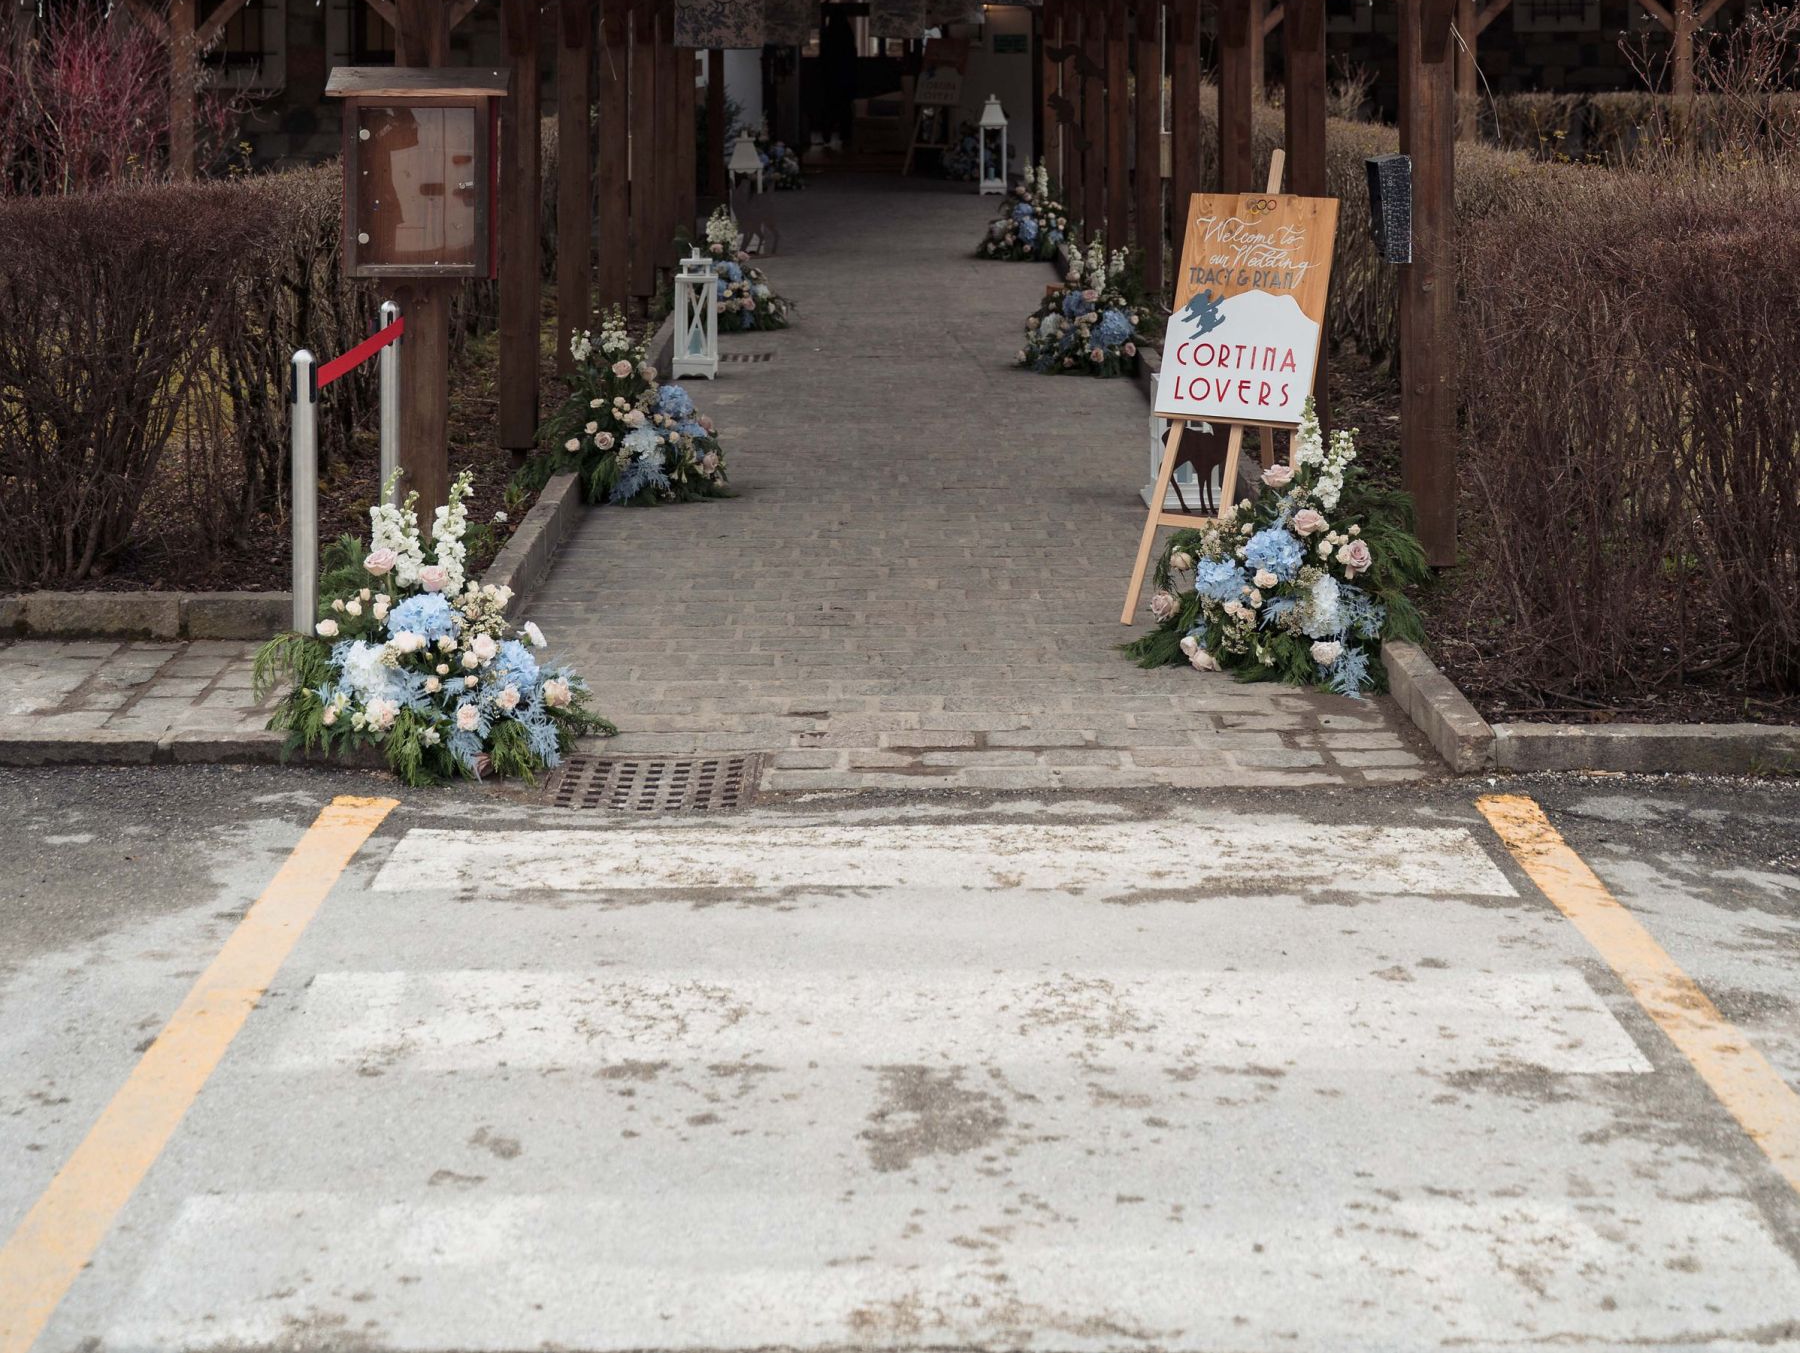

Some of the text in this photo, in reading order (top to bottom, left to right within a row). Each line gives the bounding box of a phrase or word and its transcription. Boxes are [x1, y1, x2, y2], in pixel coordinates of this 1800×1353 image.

[1196, 216, 1306, 244] Welcome to
[1189, 267, 1294, 289] TRACY & RYAN
[1209, 244, 1320, 289] our Wedding
[1176, 342, 1297, 373] CORTINA
[1173, 376, 1289, 407] LOVERS
